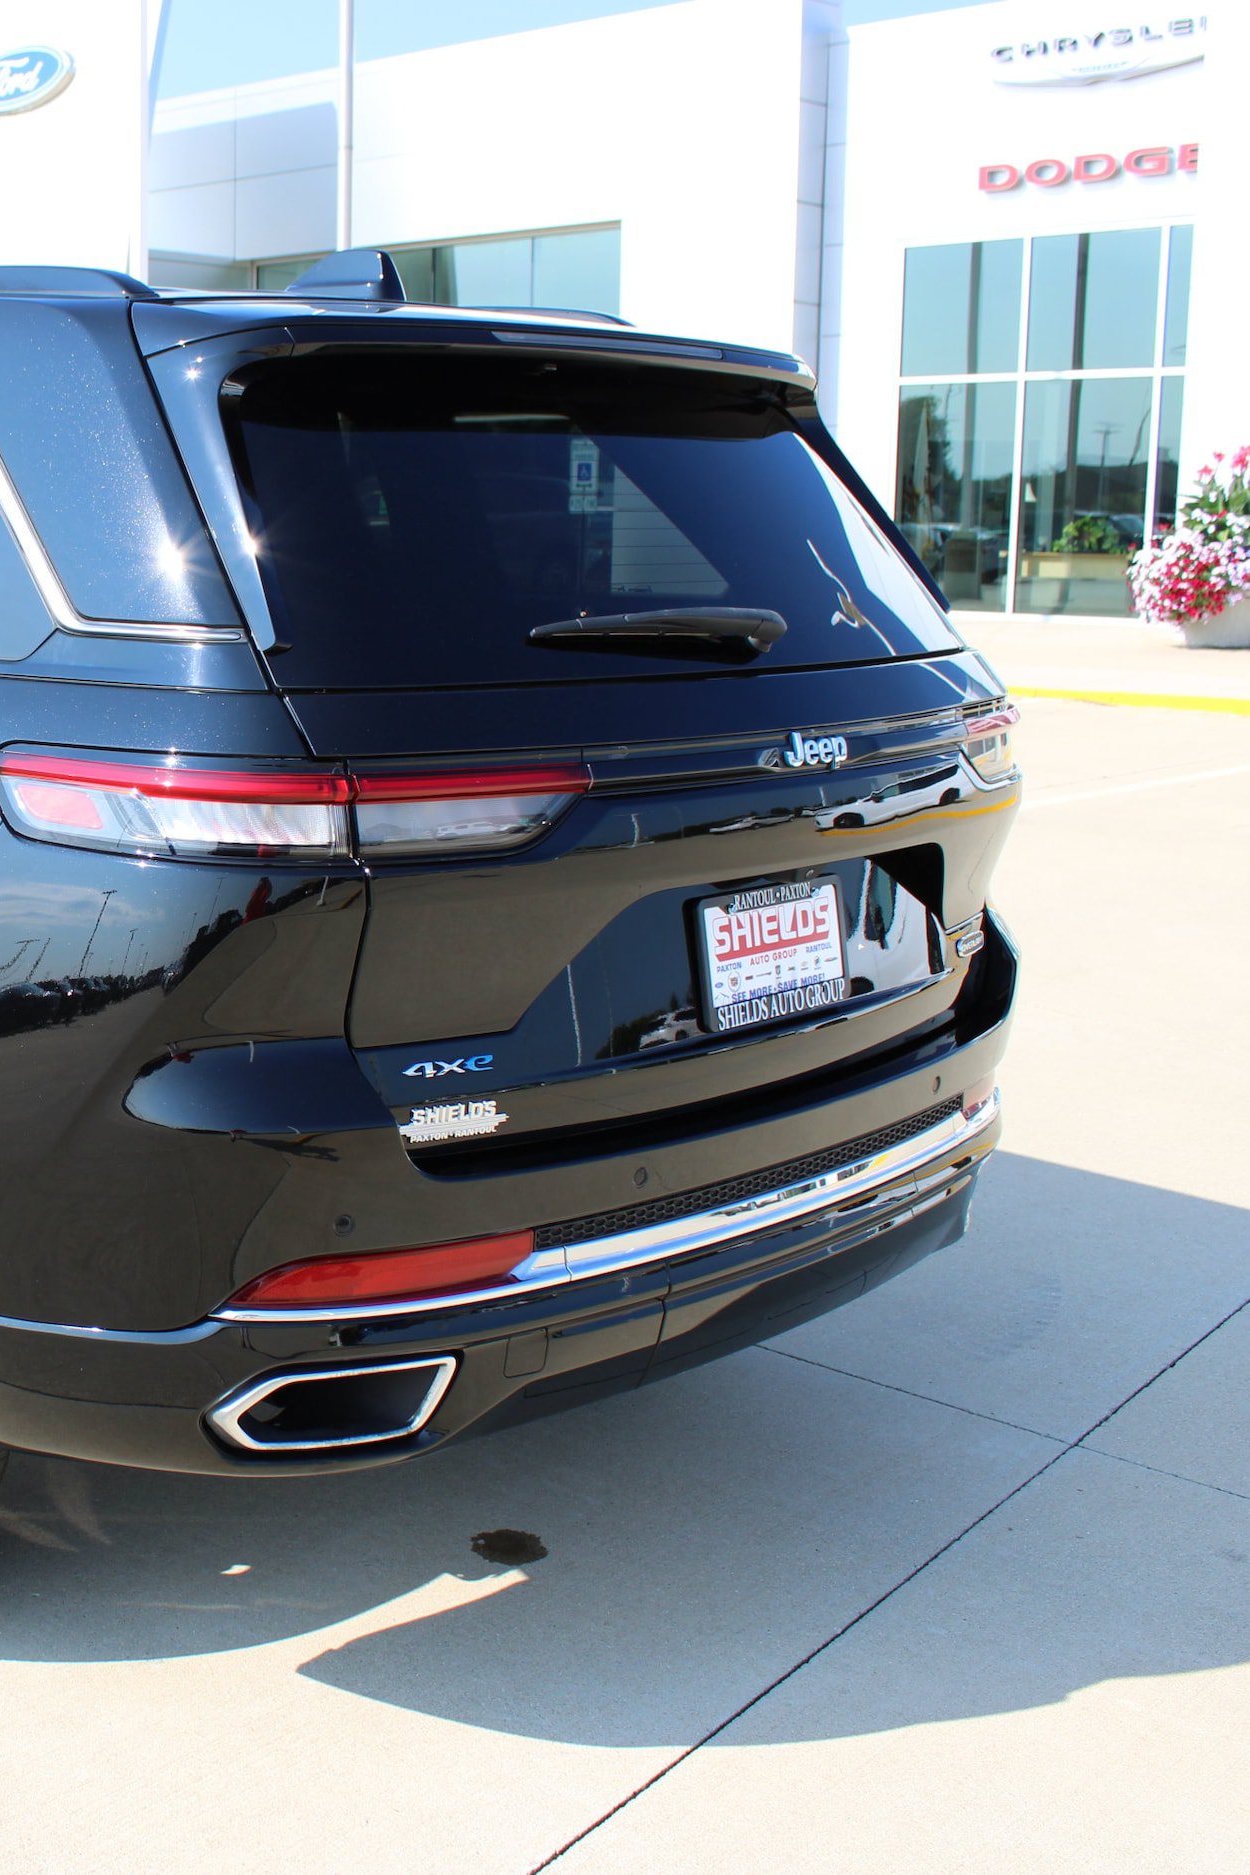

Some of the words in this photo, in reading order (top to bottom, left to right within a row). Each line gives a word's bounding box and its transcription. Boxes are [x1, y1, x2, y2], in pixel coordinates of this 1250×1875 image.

[991, 16, 1207, 63] CHRYSLE
[784, 732, 848, 769] Jeep
[734, 888, 776, 911] RANTOUL
[780, 882, 812, 901] PAXTON
[713, 897, 831, 957] SHIELDS
[716, 961, 742, 974] PAXTON
[750, 953, 770, 966] AUTO
[772, 948, 798, 962] GROUP
[717, 1000, 769, 1031] SHIELDS
[770, 989, 804, 1017] AUTO
[805, 978, 846, 1009] GROUP
[412, 1100, 497, 1126] SHIELDS
[410, 1131, 448, 1143] PAXTON
[454, 1125, 497, 1139] RANTOUL
